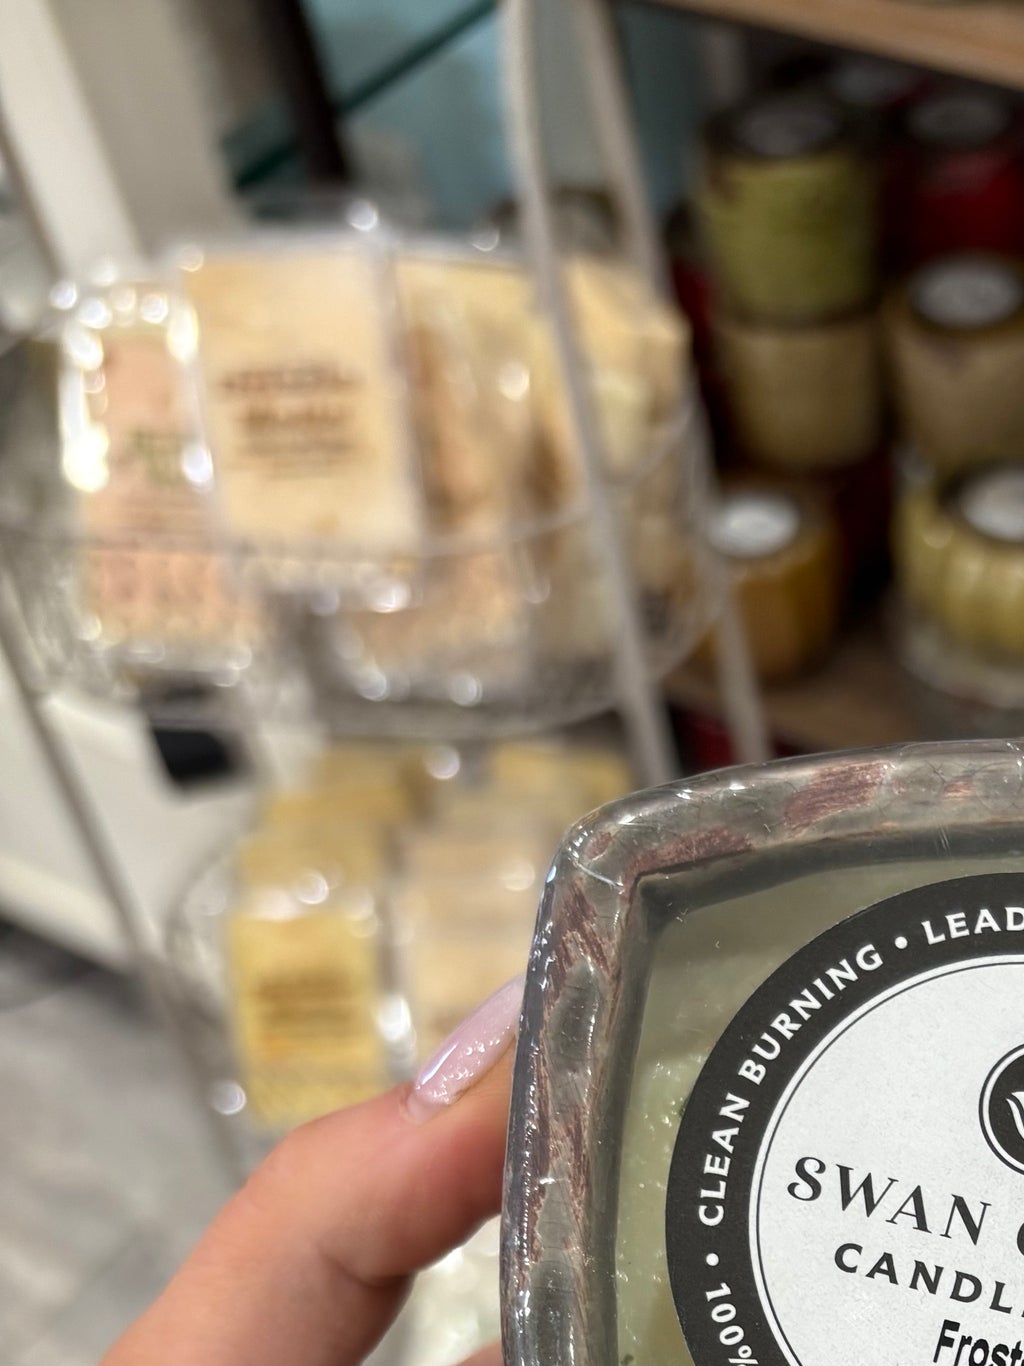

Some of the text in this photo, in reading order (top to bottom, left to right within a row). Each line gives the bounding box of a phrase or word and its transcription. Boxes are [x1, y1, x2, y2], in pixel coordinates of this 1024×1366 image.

[698, 943, 884, 1227] CLEAN BURNING
[787, 1156, 991, 1246] SWAN
